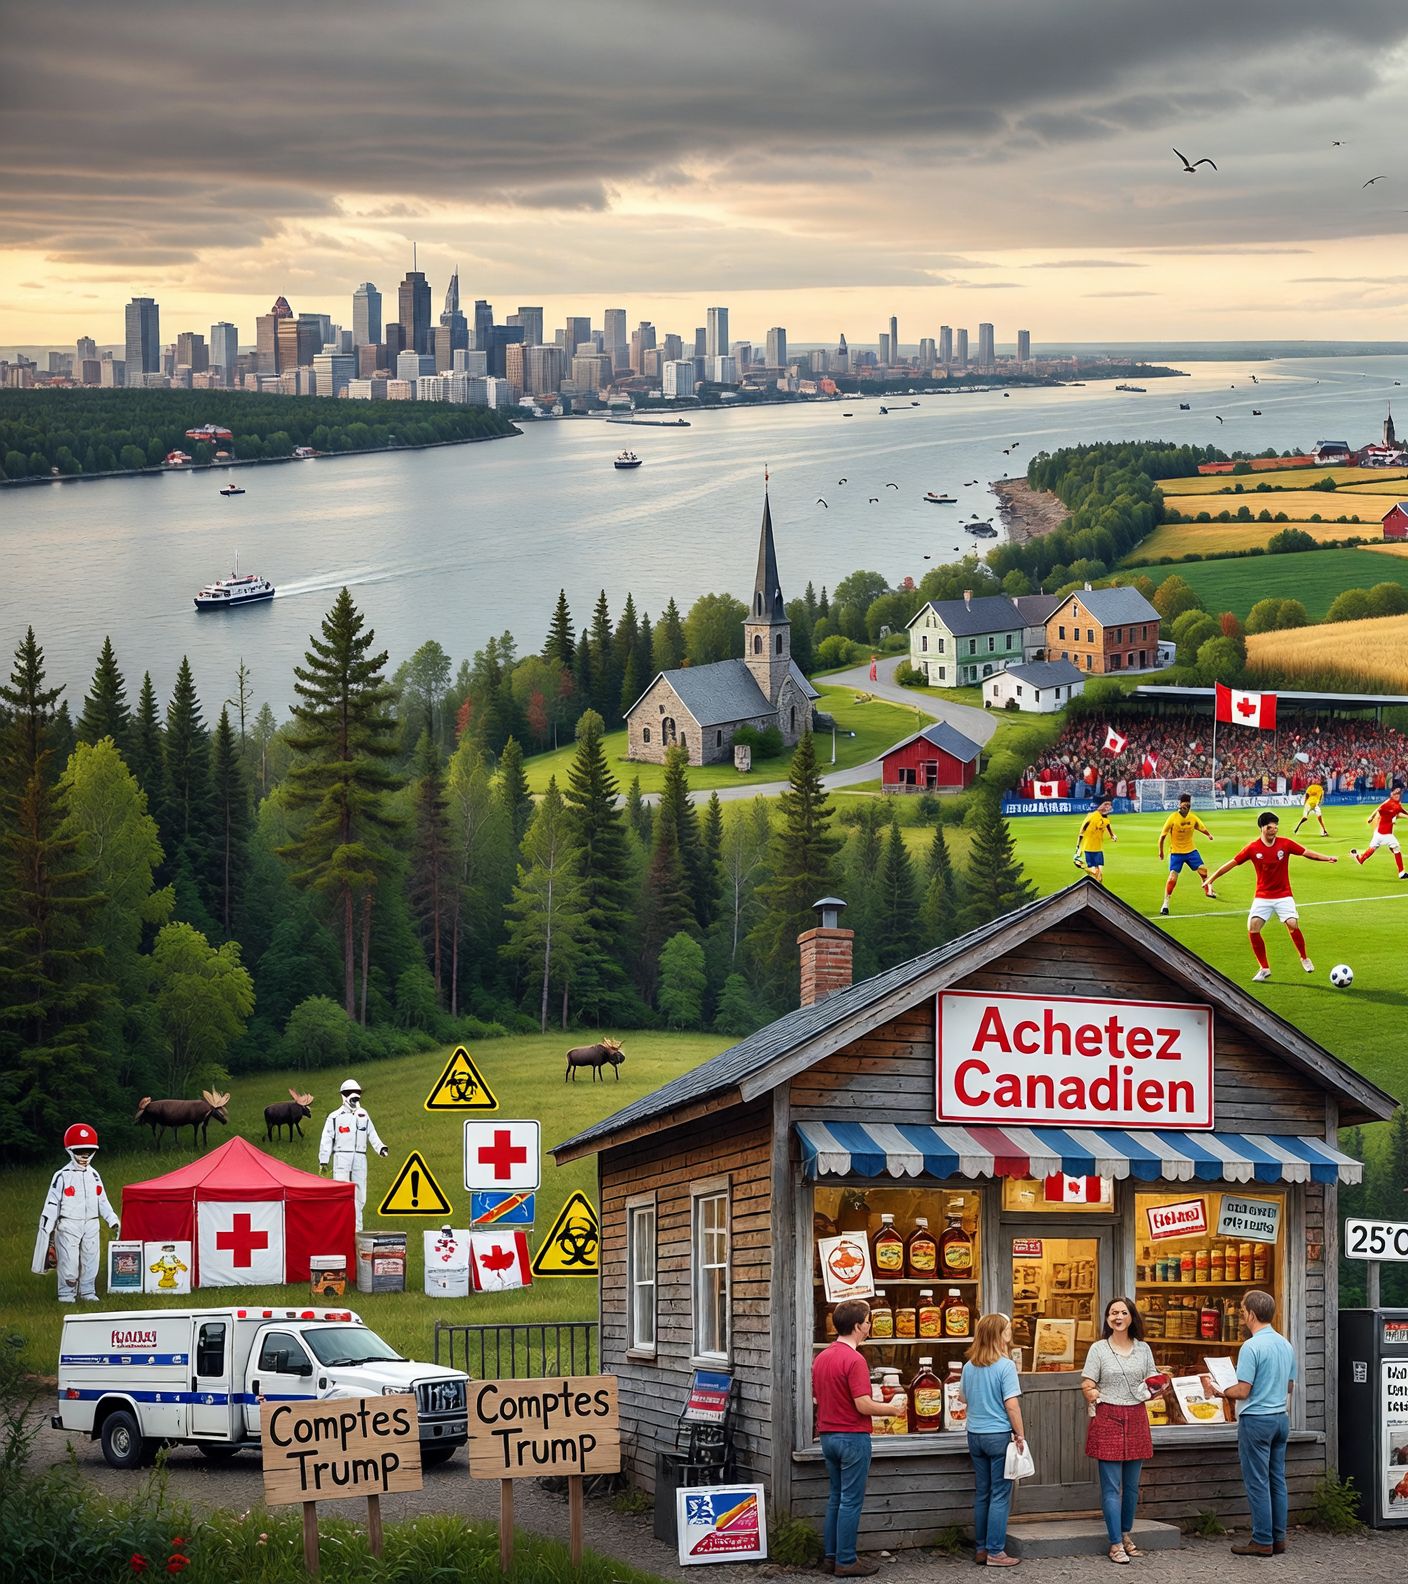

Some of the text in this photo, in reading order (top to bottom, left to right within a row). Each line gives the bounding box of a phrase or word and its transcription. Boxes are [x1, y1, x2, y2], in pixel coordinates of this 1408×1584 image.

[971, 1005, 1183, 1061] Achetez
[953, 1057, 1196, 1114] Canadien
[269, 1398, 412, 1452] Comptes
[475, 1380, 611, 1430] Comptes
[285, 1448, 401, 1493] Trump
[489, 1426, 598, 1474] Trump
